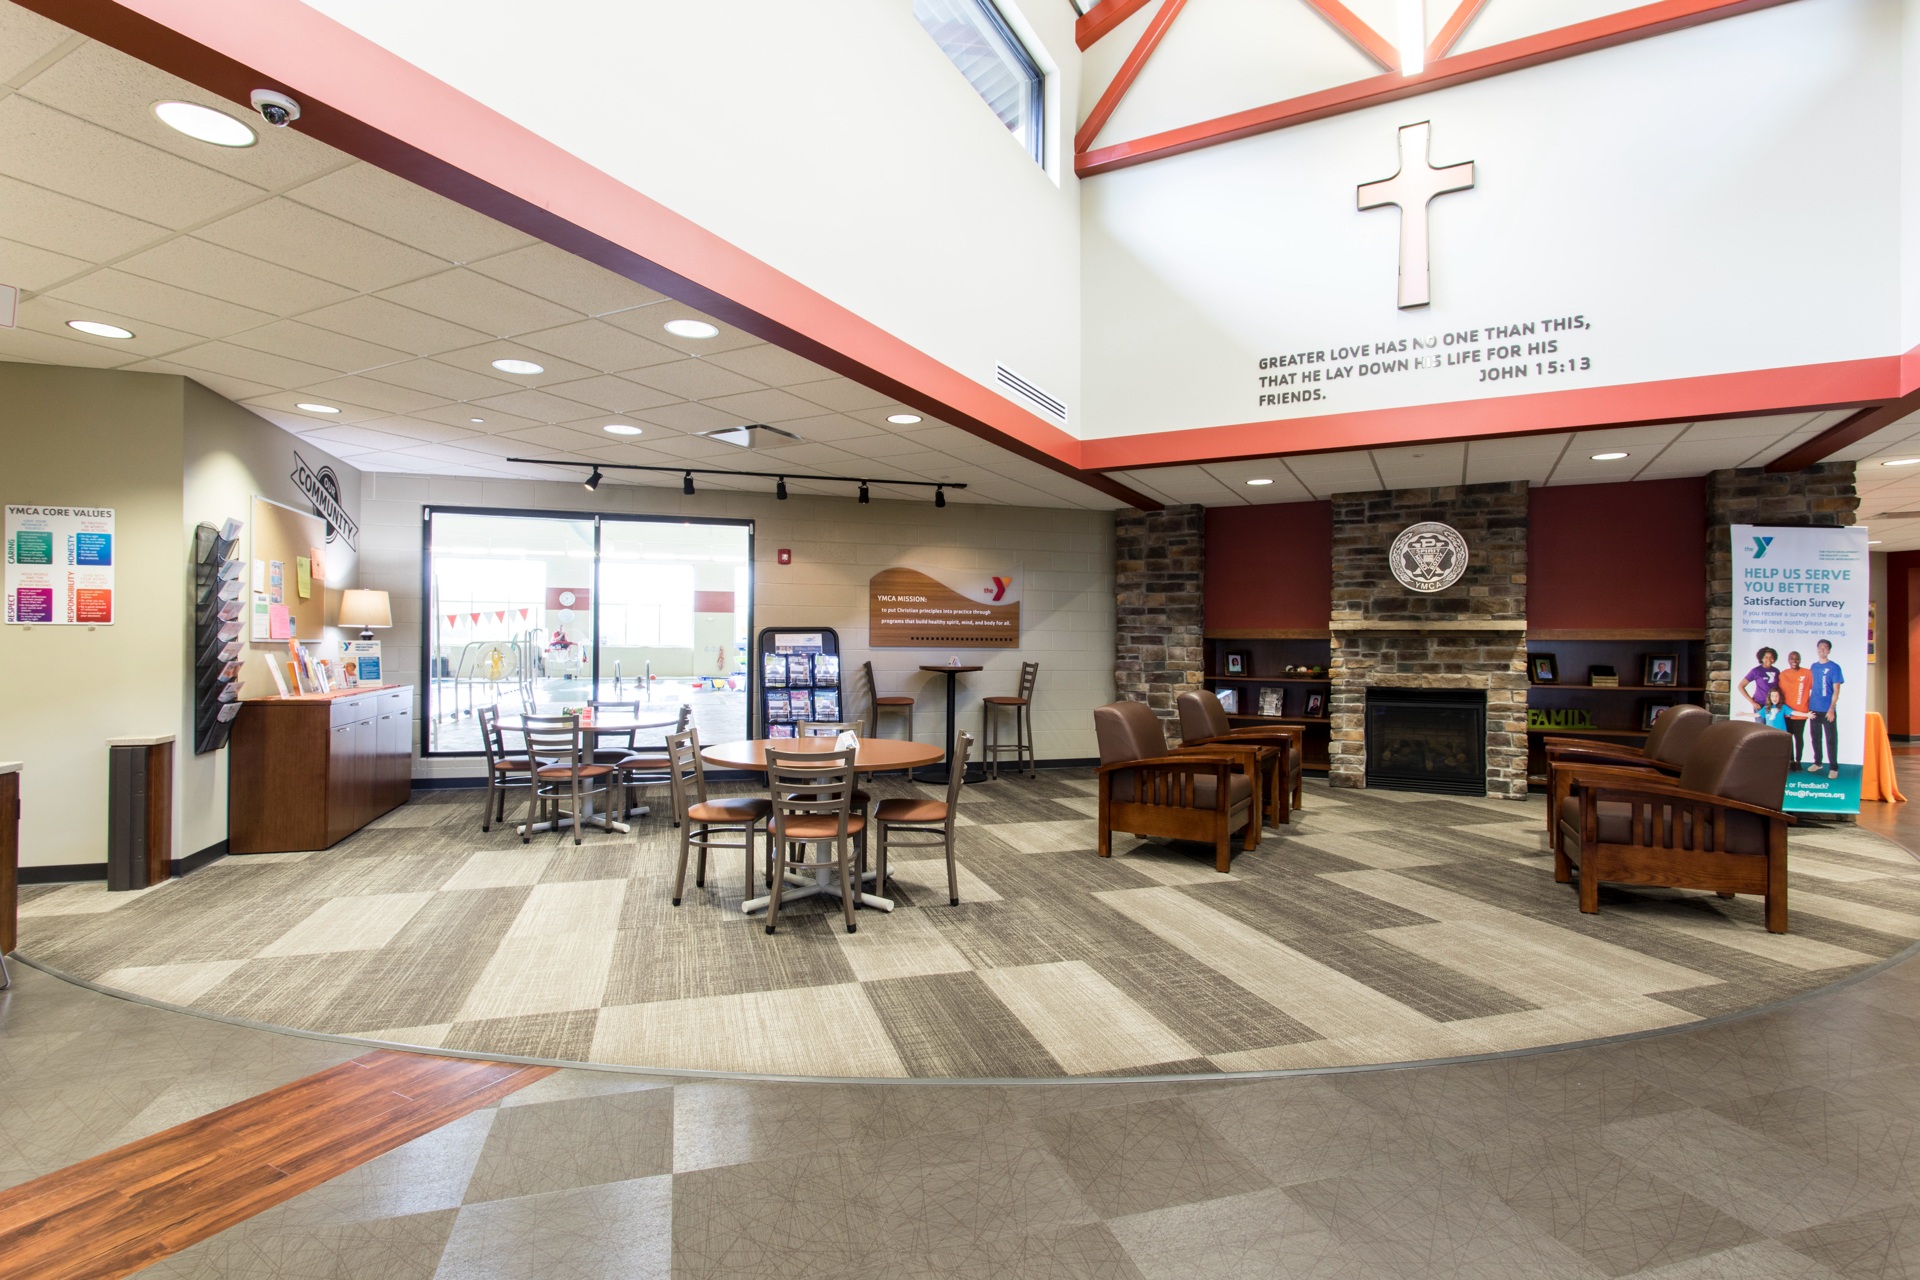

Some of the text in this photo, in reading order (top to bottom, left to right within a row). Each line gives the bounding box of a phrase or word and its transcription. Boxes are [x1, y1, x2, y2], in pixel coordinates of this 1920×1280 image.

[1259, 315, 1591, 370] GREATER LOVE HAS NO ONE THAN THIS,
[1259, 339, 1558, 388] THAT HE LAY DOWN HIS LIFE FOR HIS
[1479, 357, 1591, 382] JOHN 15:13
[1259, 388, 1326, 406] FRIENDS.
[324, 477, 336, 497] OUR
[9, 507, 112, 518] YMCA CORE VALUES
[299, 467, 353, 540] COMMUNITY
[67, 534, 75, 566] HONESTY
[1414, 554, 1427, 571] MIND
[1745, 568, 1851, 580] HELP US SERVE
[1414, 581, 1442, 590] YMCA
[1744, 581, 1830, 594] YOU BETTER
[67, 571, 75, 623] RESPONSIBILITY
[1744, 596, 1845, 609] Satisfaction Survey
[7, 594, 15, 622] RESPECT
[1527, 709, 1593, 727] FAMILY
[1797, 781, 1829, 789] Feedback?
